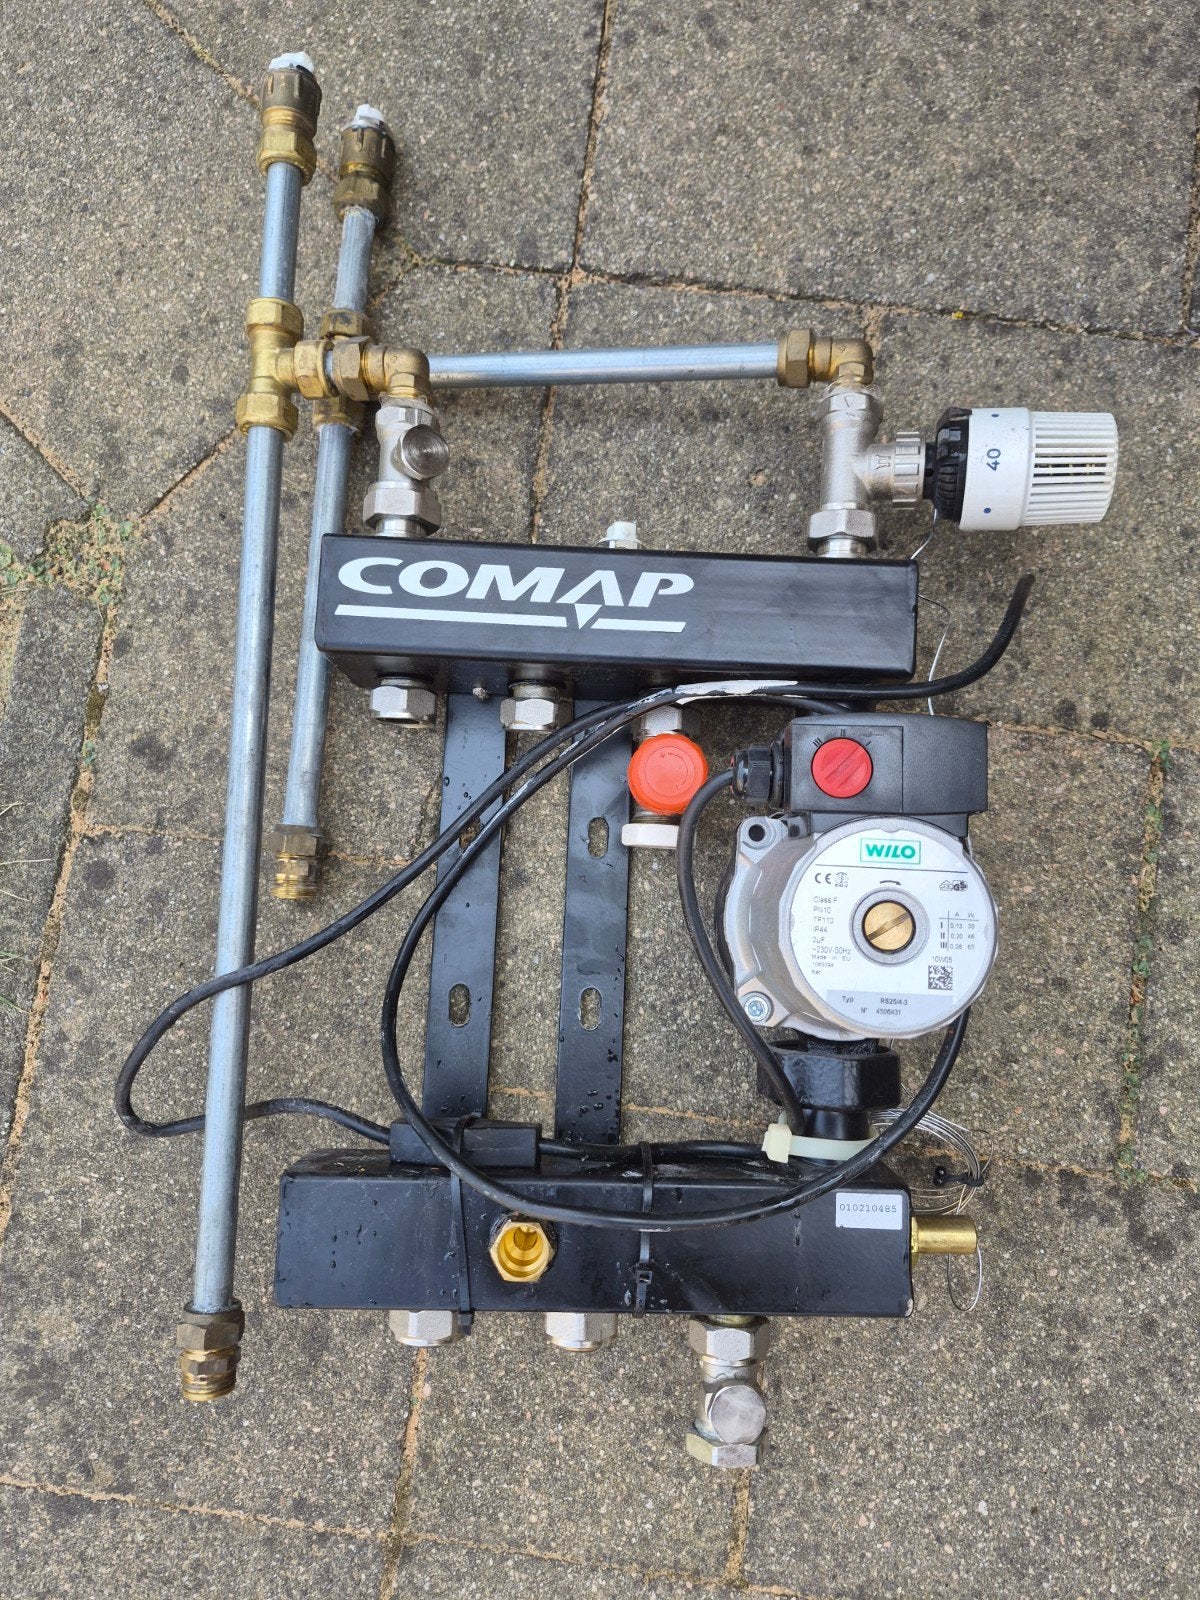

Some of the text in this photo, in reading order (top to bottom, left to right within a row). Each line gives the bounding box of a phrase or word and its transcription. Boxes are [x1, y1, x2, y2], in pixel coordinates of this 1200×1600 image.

[986, 448, 1001, 471] 40
[338, 557, 695, 607] COMAP
[865, 844, 916, 859] WILO
[815, 872, 831, 885] CE
[813, 895, 831, 904] Class
[813, 906, 831, 914] PN10
[813, 916, 834, 924] TF110
[842, 996, 854, 1004] Typ
[840, 1203, 897, 1213] 010210485
